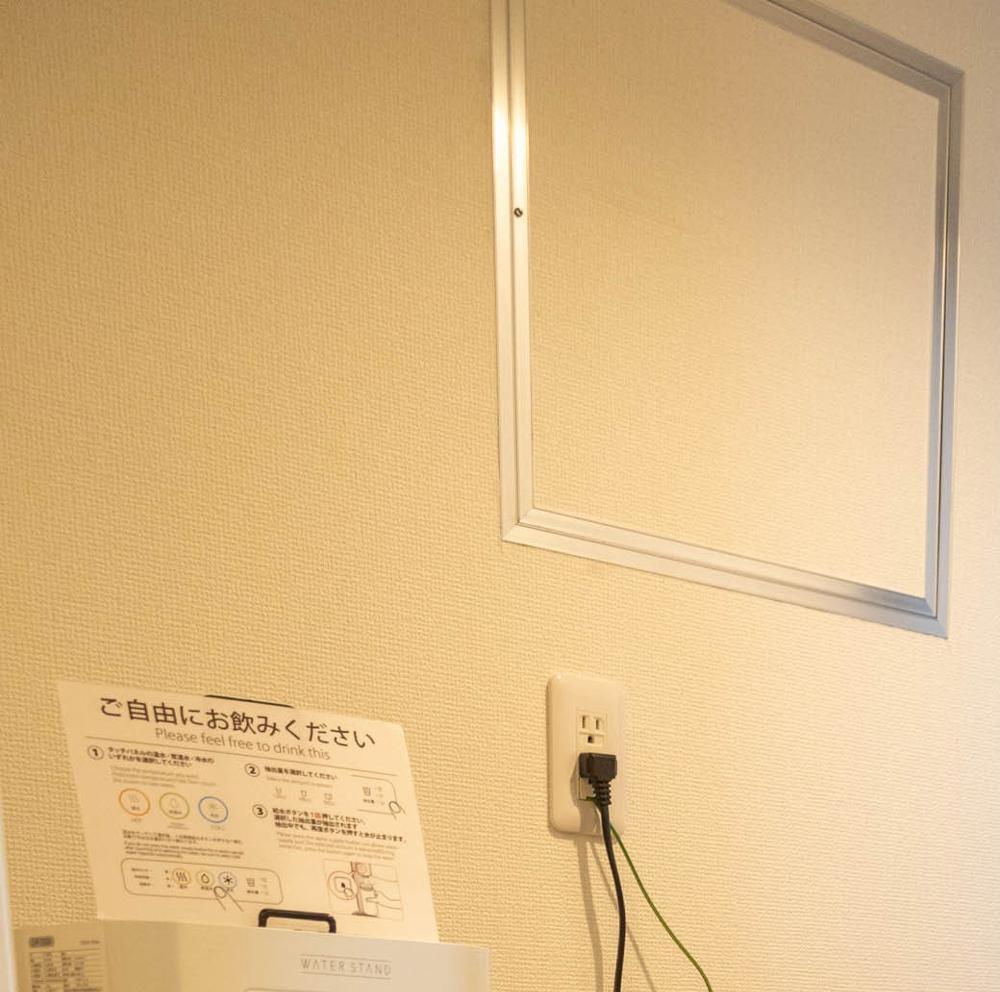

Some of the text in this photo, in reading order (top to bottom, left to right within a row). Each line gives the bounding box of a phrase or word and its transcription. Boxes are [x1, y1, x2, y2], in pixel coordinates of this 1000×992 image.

[100, 697, 376, 749] ご自由にお飲みください
[155, 727, 331, 760] Please feel free to drink this
[300, 958, 392, 977] WATER STAND
